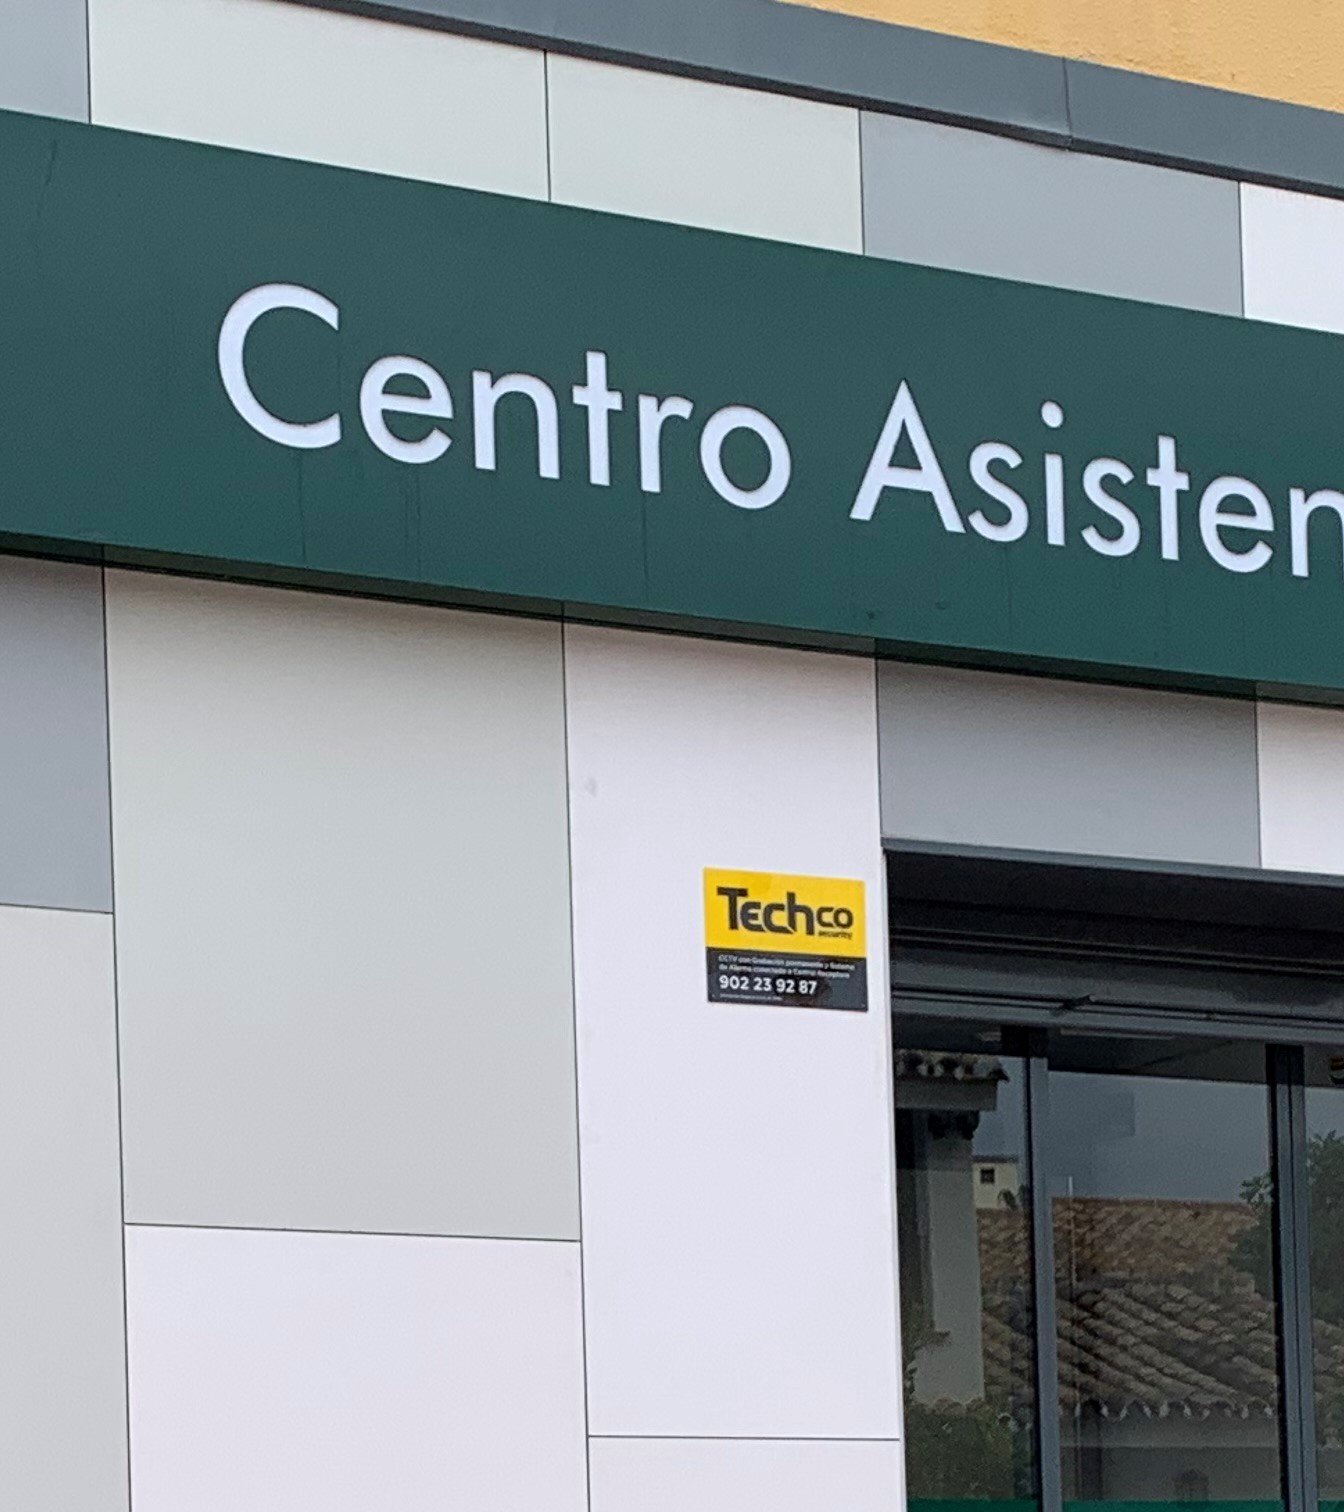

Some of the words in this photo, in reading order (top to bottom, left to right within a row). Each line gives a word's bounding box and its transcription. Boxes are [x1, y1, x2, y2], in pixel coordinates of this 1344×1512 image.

[217, 283, 792, 510] Centro
[718, 974, 749, 989] 902
[753, 977, 772, 991] 23
[775, 978, 795, 993] 92
[798, 979, 817, 994] 87
